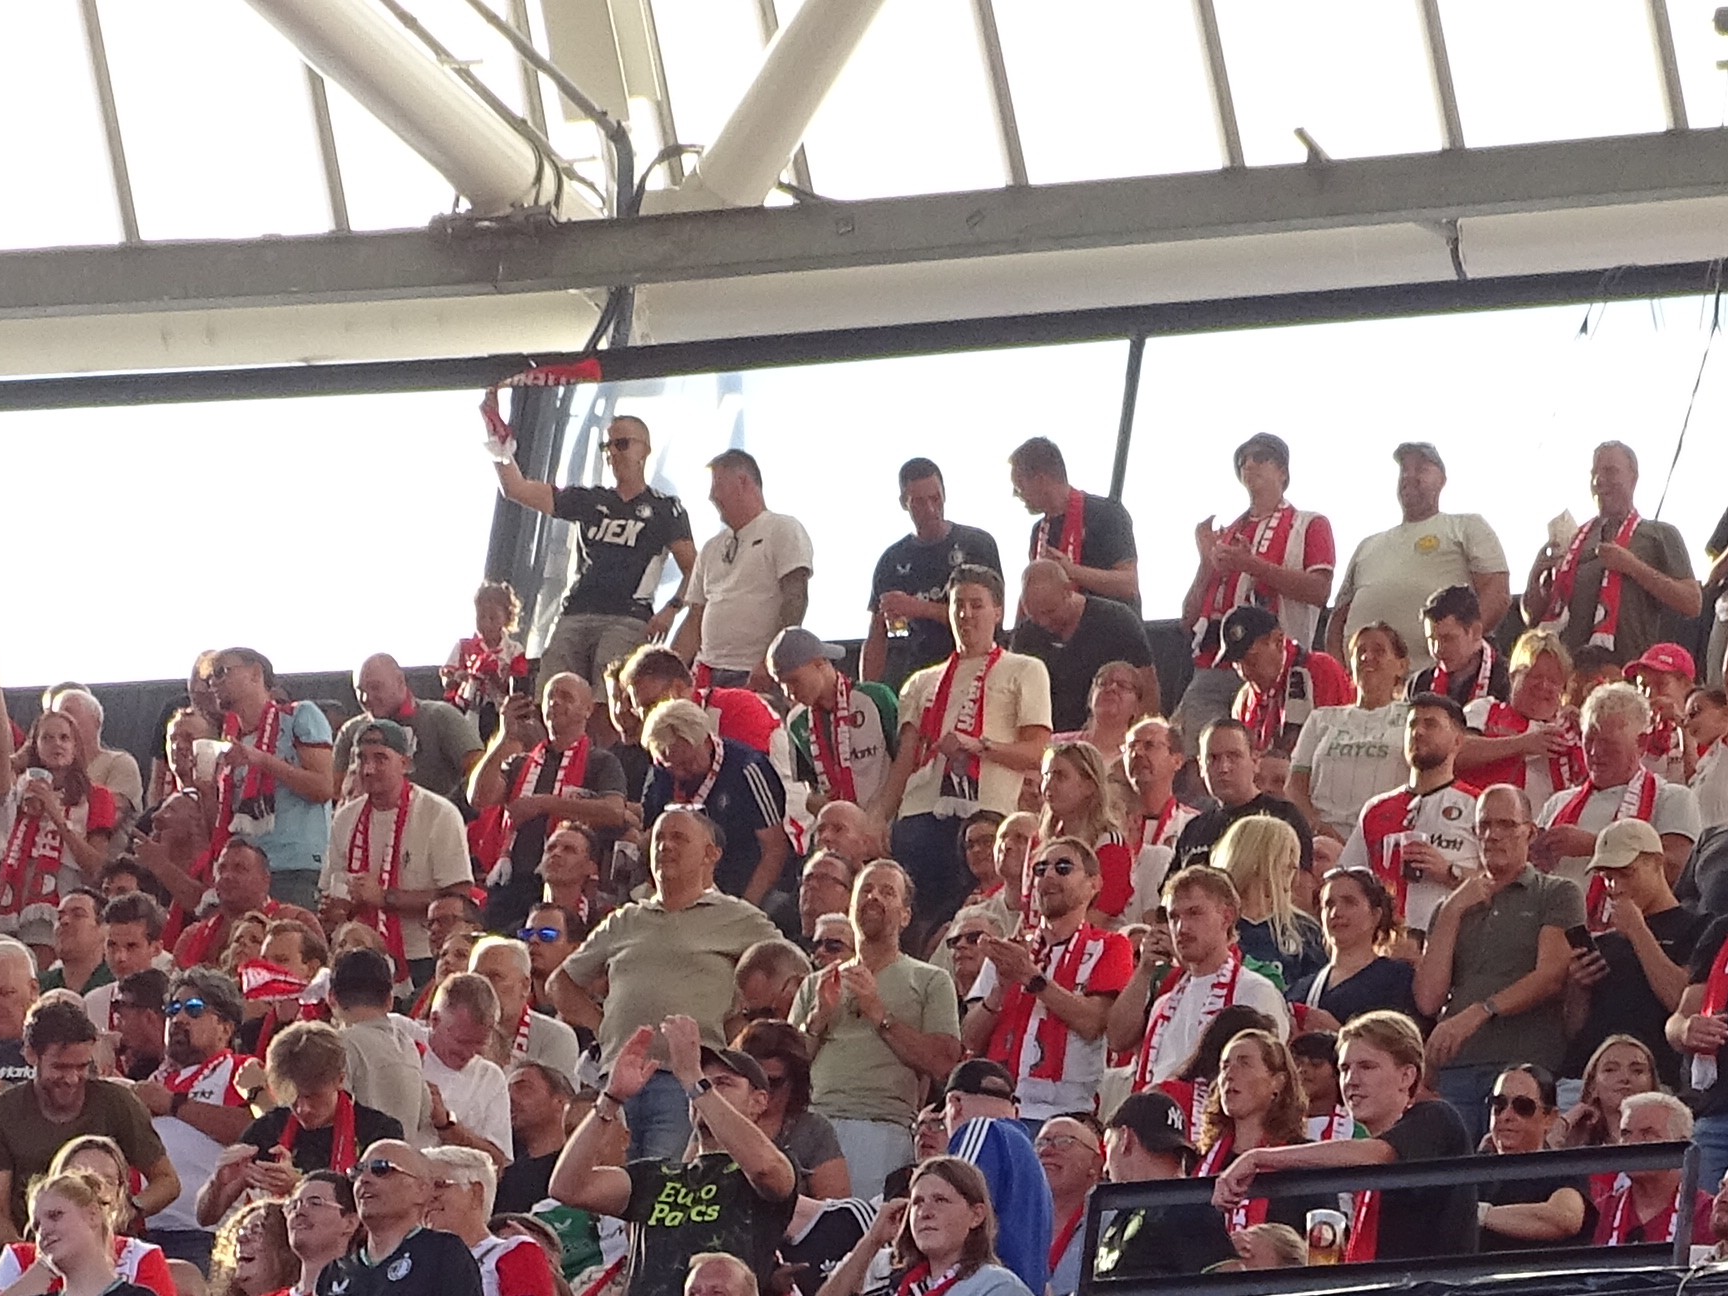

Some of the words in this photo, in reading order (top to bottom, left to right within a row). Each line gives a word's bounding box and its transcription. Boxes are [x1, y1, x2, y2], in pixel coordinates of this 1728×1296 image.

[1325, 741, 1390, 759] Parcs
[658, 1180, 718, 1207] Euo
[647, 1202, 721, 1227] Pacs
